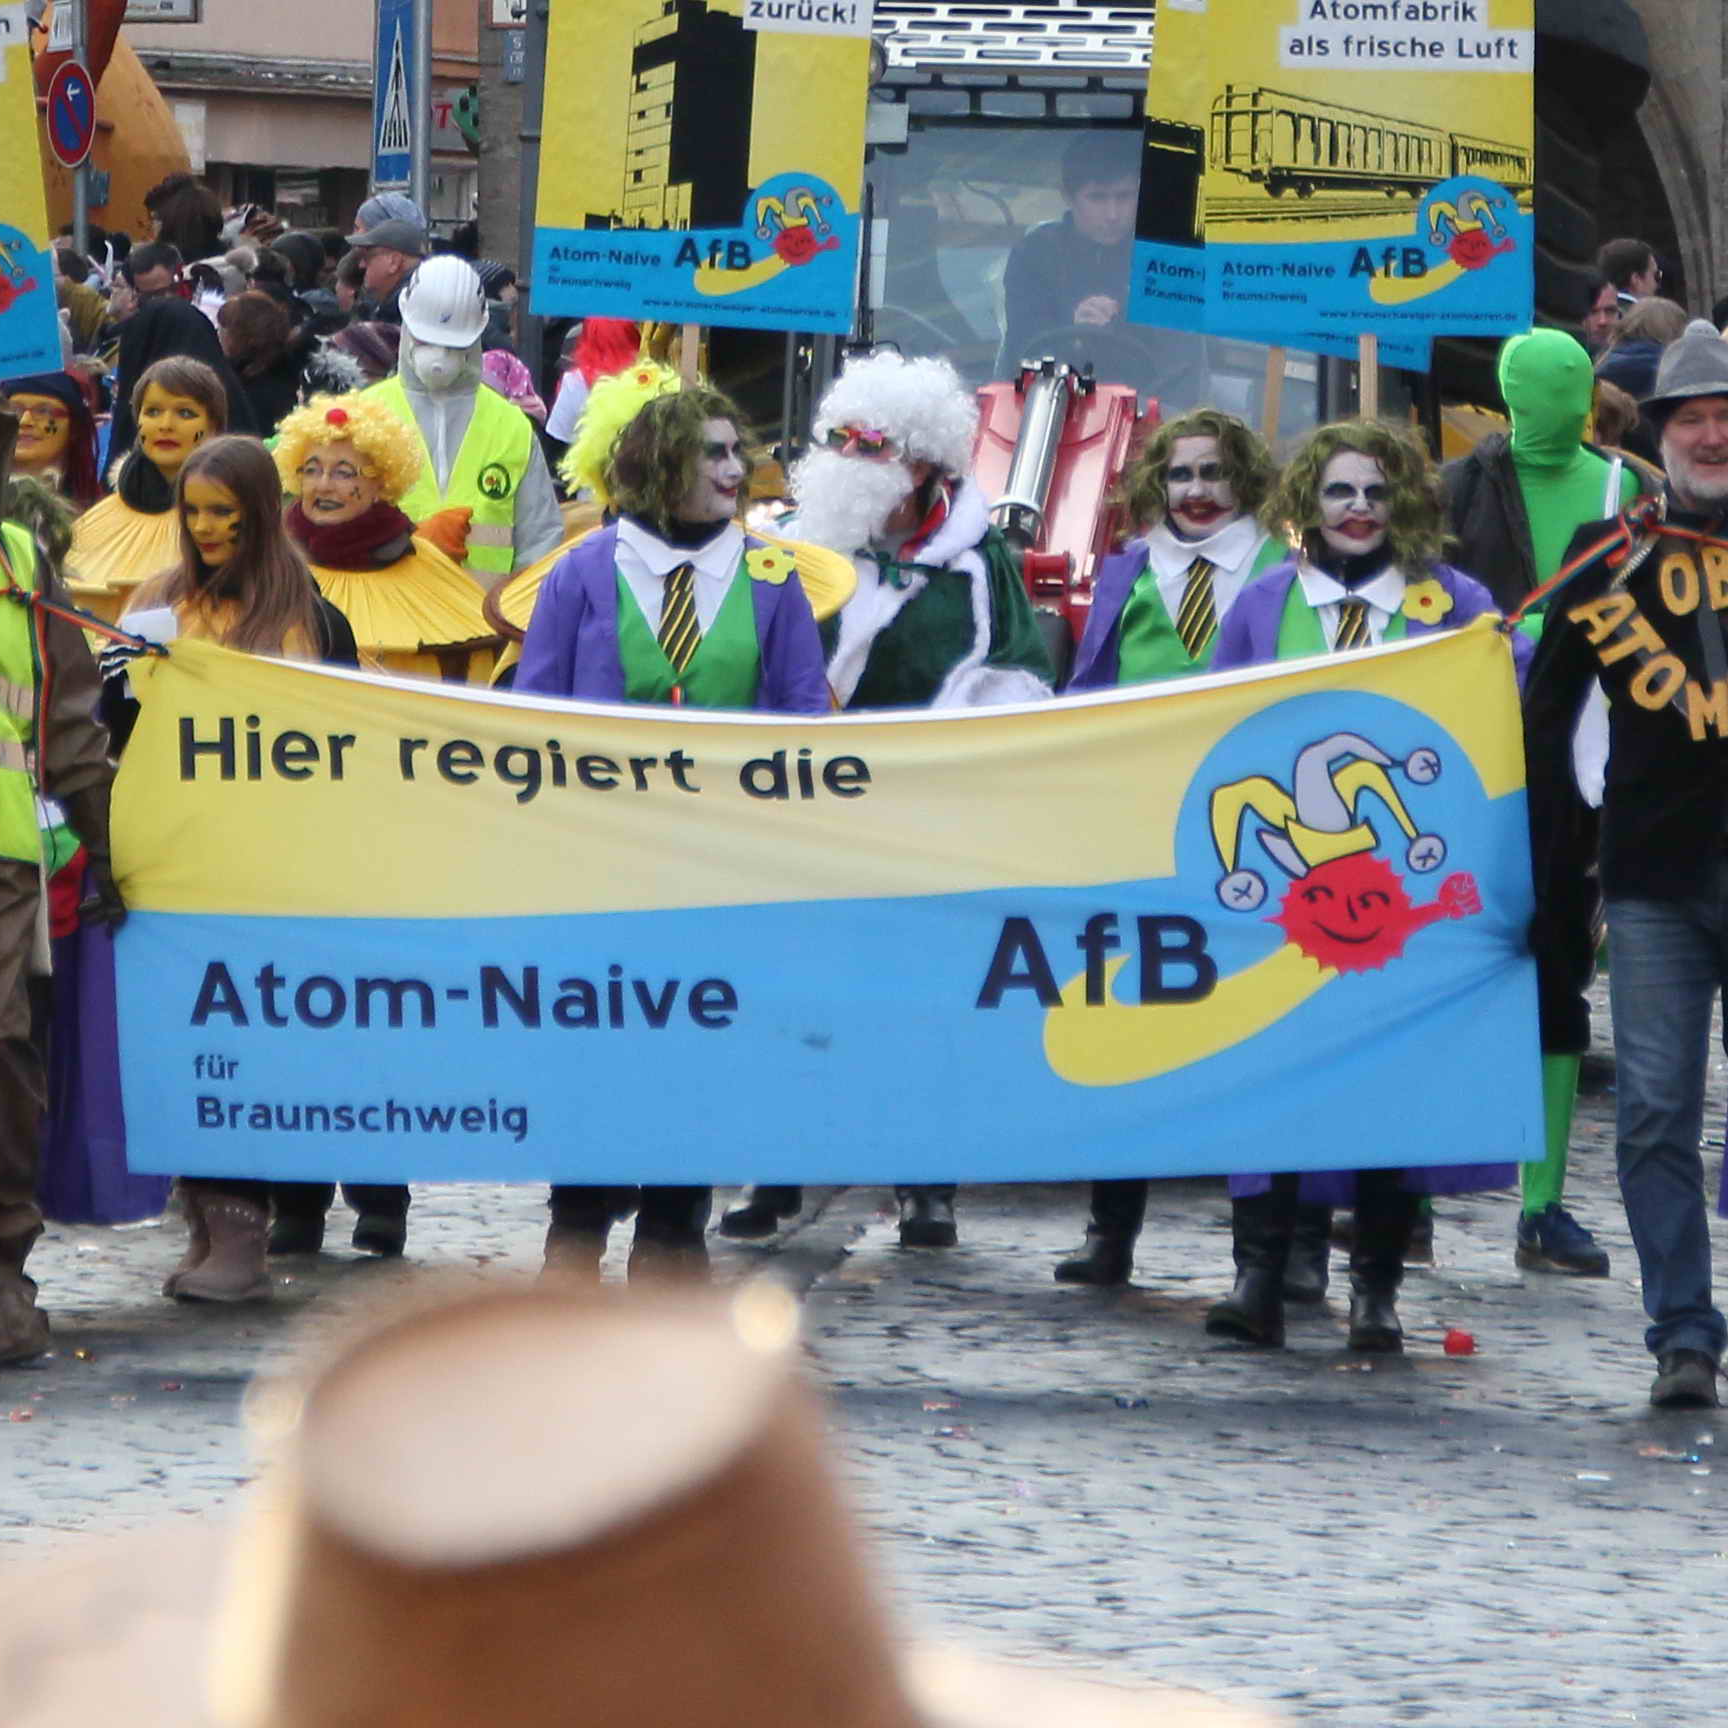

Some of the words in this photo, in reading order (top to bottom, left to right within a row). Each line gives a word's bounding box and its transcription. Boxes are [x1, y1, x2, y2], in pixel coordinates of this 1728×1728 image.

[750, 0, 857, 23] zurück!
[1309, 0, 1477, 23] Atomfabrik
[1288, 37, 1330, 57] als
[1343, 36, 1445, 59] frische
[1457, 38, 1518, 60] Luft
[549, 246, 662, 267] Atom-Naive
[675, 237, 753, 270] AfB
[1348, 247, 1427, 278] AfB
[1146, 259, 1206, 280] Atom-
[1222, 261, 1336, 279] Atom-Naive
[178, 716, 357, 783] Hier
[398, 736, 702, 804] regiert
[738, 747, 872, 802] die
[974, 913, 1219, 1009] AfB
[189, 961, 739, 1030] Atom-Naive
[194, 1055, 239, 1080] für
[196, 1097, 529, 1141] Braunschweig
